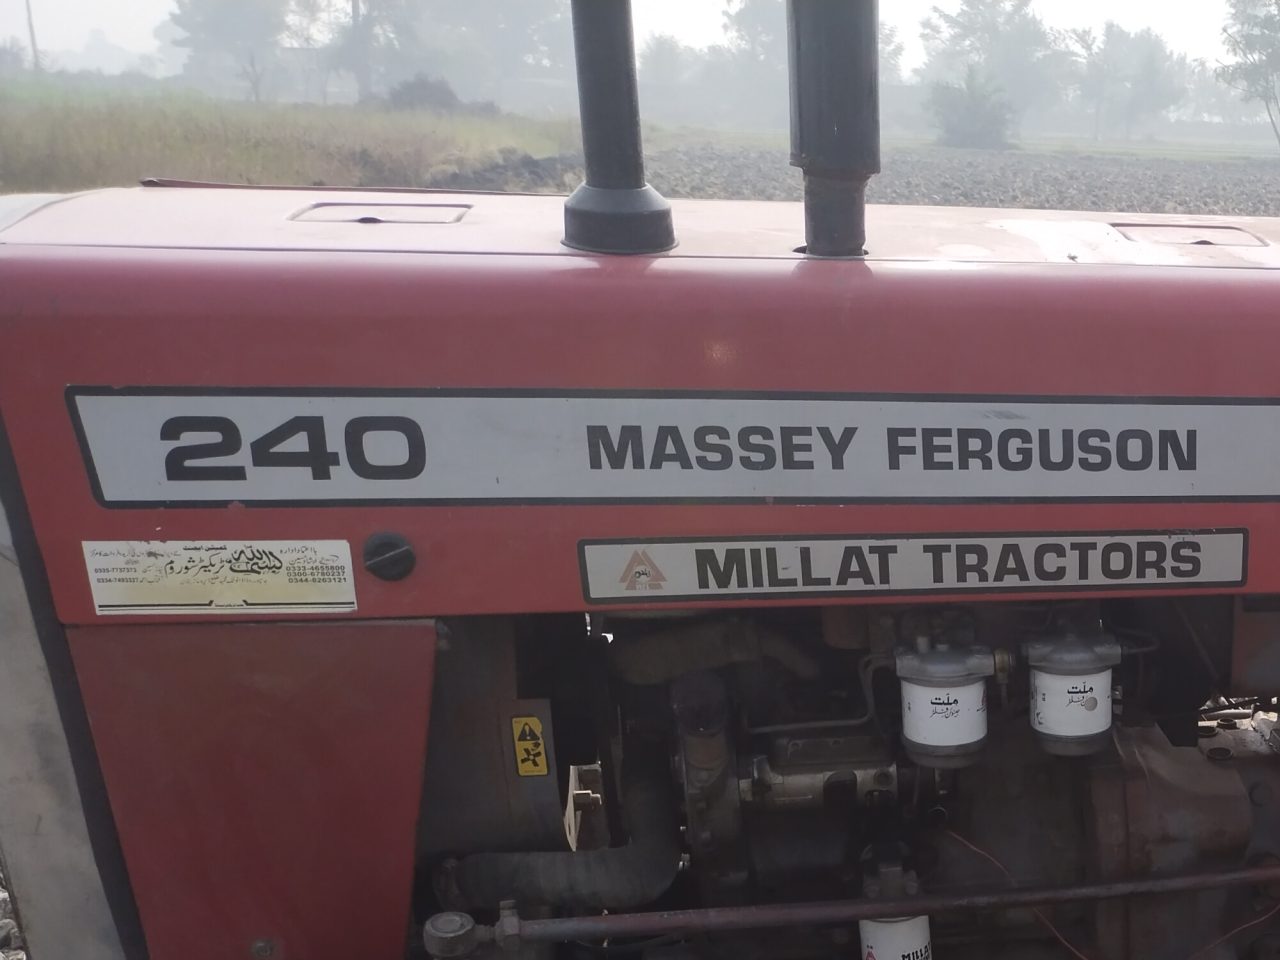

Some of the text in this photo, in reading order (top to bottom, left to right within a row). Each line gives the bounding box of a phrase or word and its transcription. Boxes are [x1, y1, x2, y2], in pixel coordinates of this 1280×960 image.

[160, 416, 427, 481] 240
[586, 425, 1198, 472] MASSEY FERGUSON
[696, 541, 1201, 590] MILLAT TRACTORS
